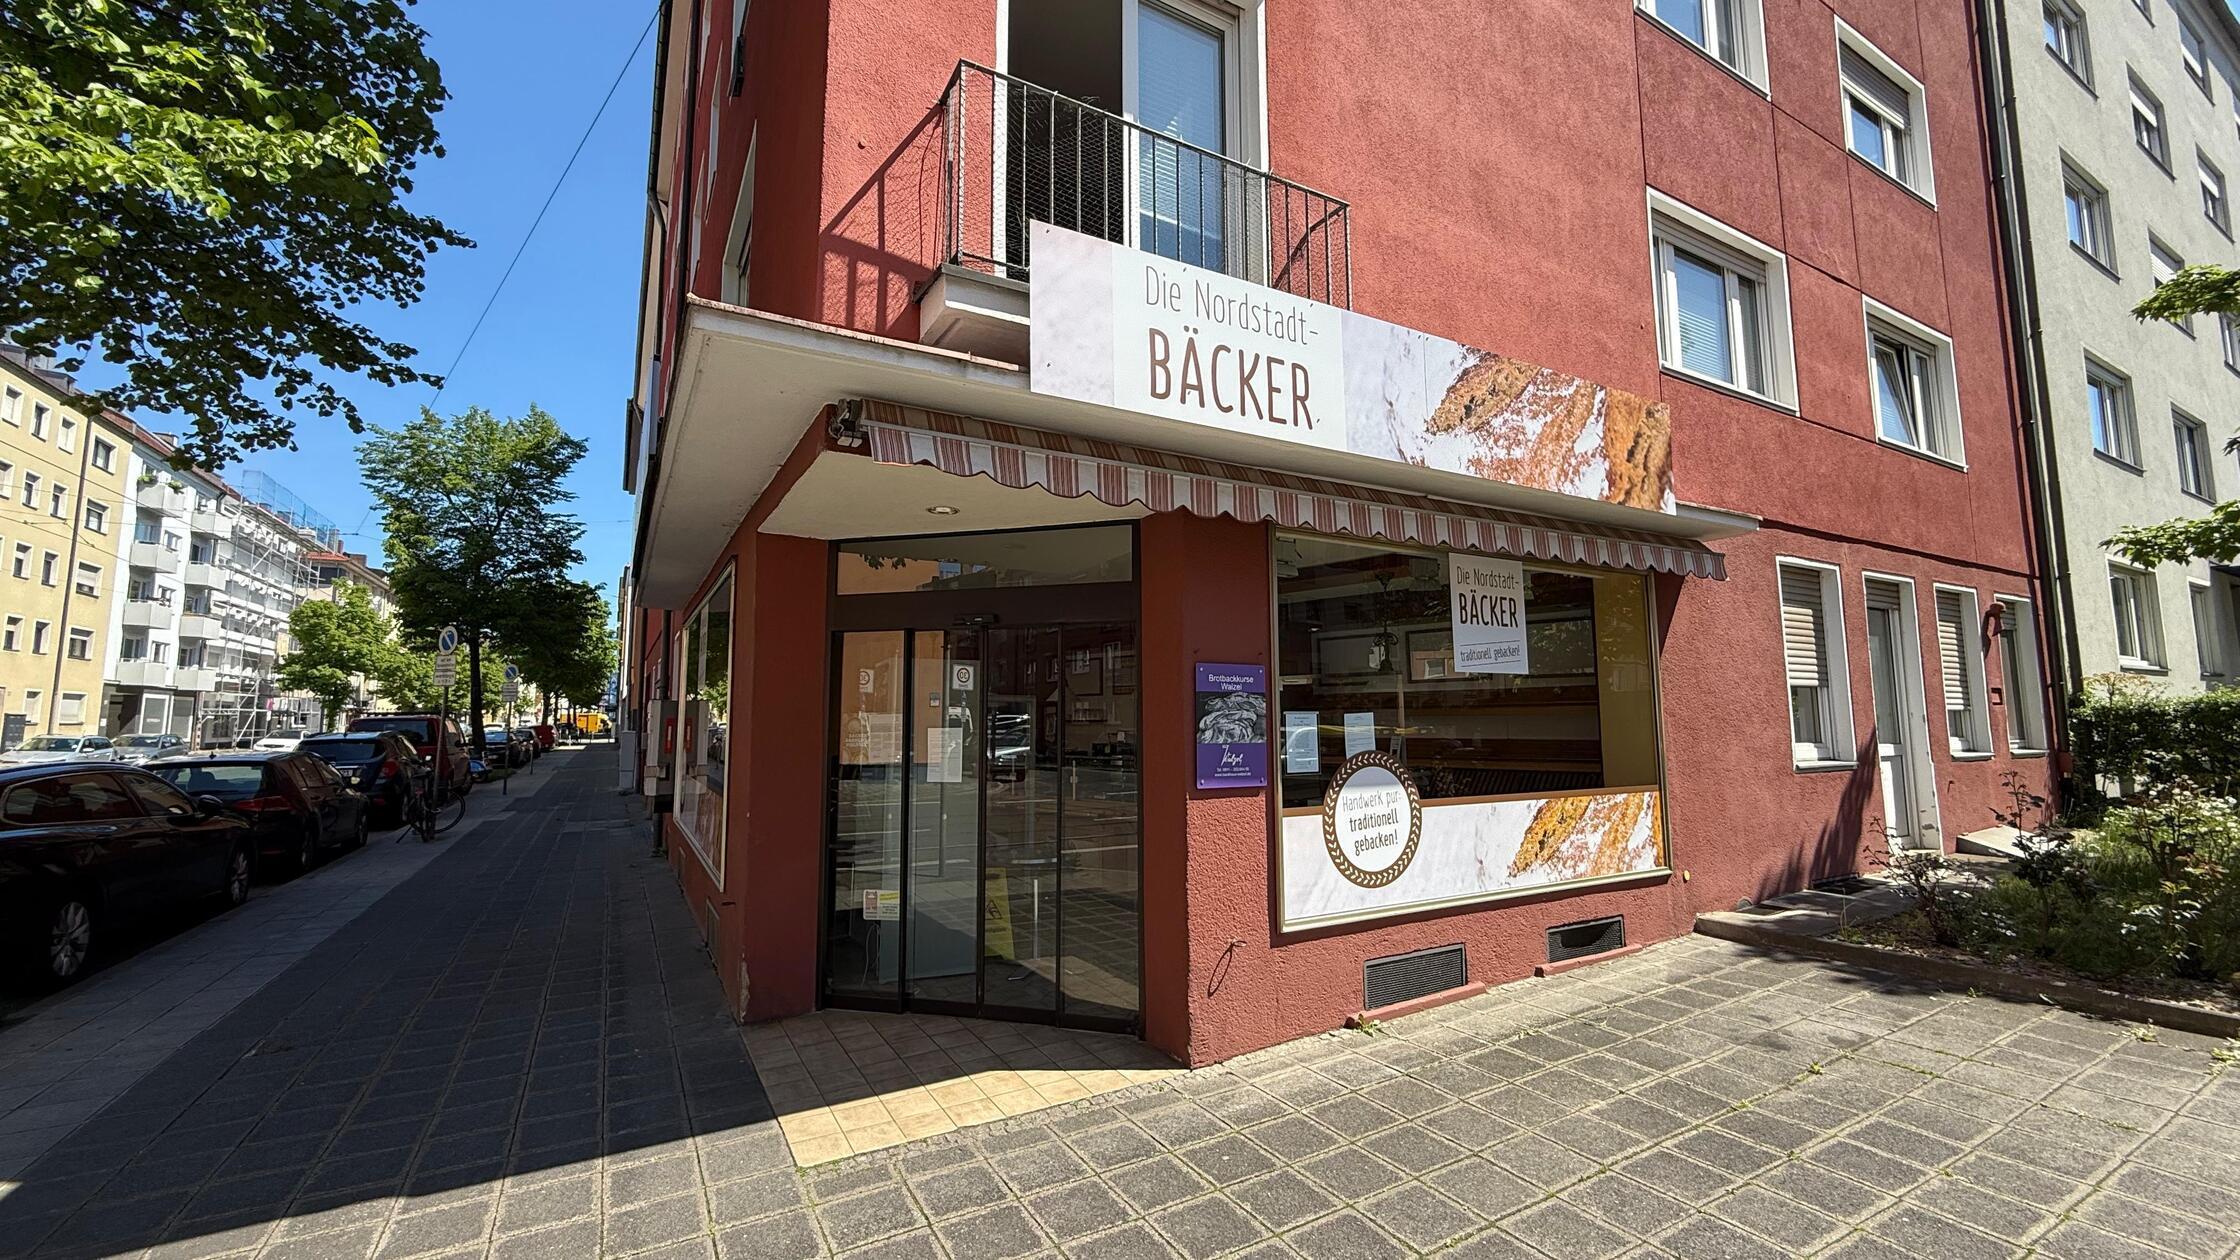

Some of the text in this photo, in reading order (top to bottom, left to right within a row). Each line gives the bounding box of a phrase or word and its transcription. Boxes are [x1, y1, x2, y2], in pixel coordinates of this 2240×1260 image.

[1145, 265, 1319, 345] Die Nordstadt-
[1149, 325, 1313, 430] BÄCKER
[1456, 566, 1520, 590] Die Nordstadt-
[1458, 589, 1519, 628] BÄCKER
[1460, 644, 1520, 662] traditionell gebacken!
[1208, 674, 1254, 683] Brotbackkurse
[1342, 789, 1384, 812] Handwerk
[1349, 807, 1399, 832] traditionell
[1354, 828, 1399, 857] gebacken!
